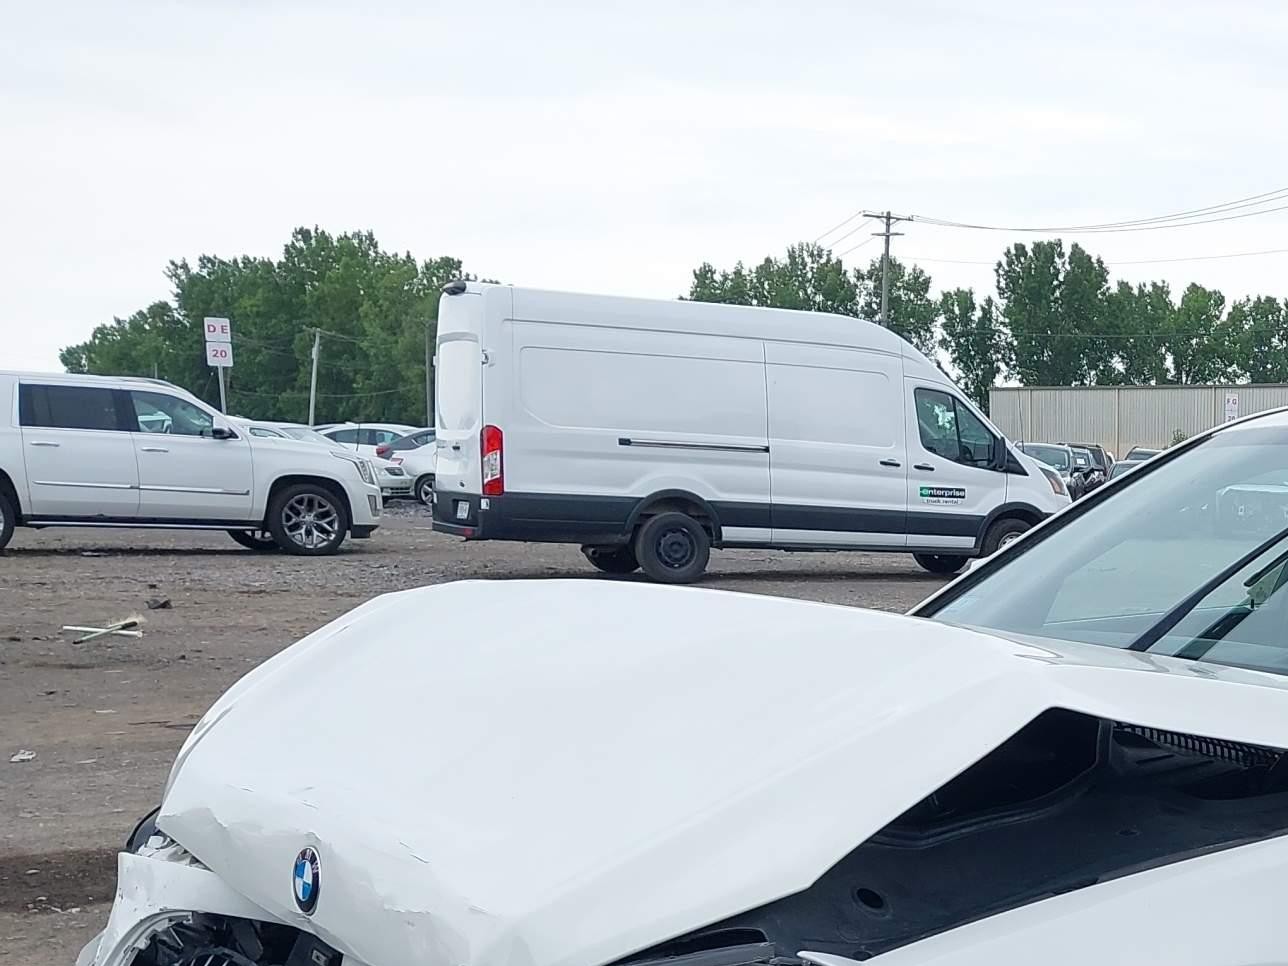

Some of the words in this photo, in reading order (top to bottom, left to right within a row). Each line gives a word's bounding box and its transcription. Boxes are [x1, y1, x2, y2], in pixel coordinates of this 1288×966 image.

[207, 324, 216, 333] D
[220, 324, 229, 334] E
[211, 348, 227, 358] 20
[920, 488, 965, 497] enterprise
